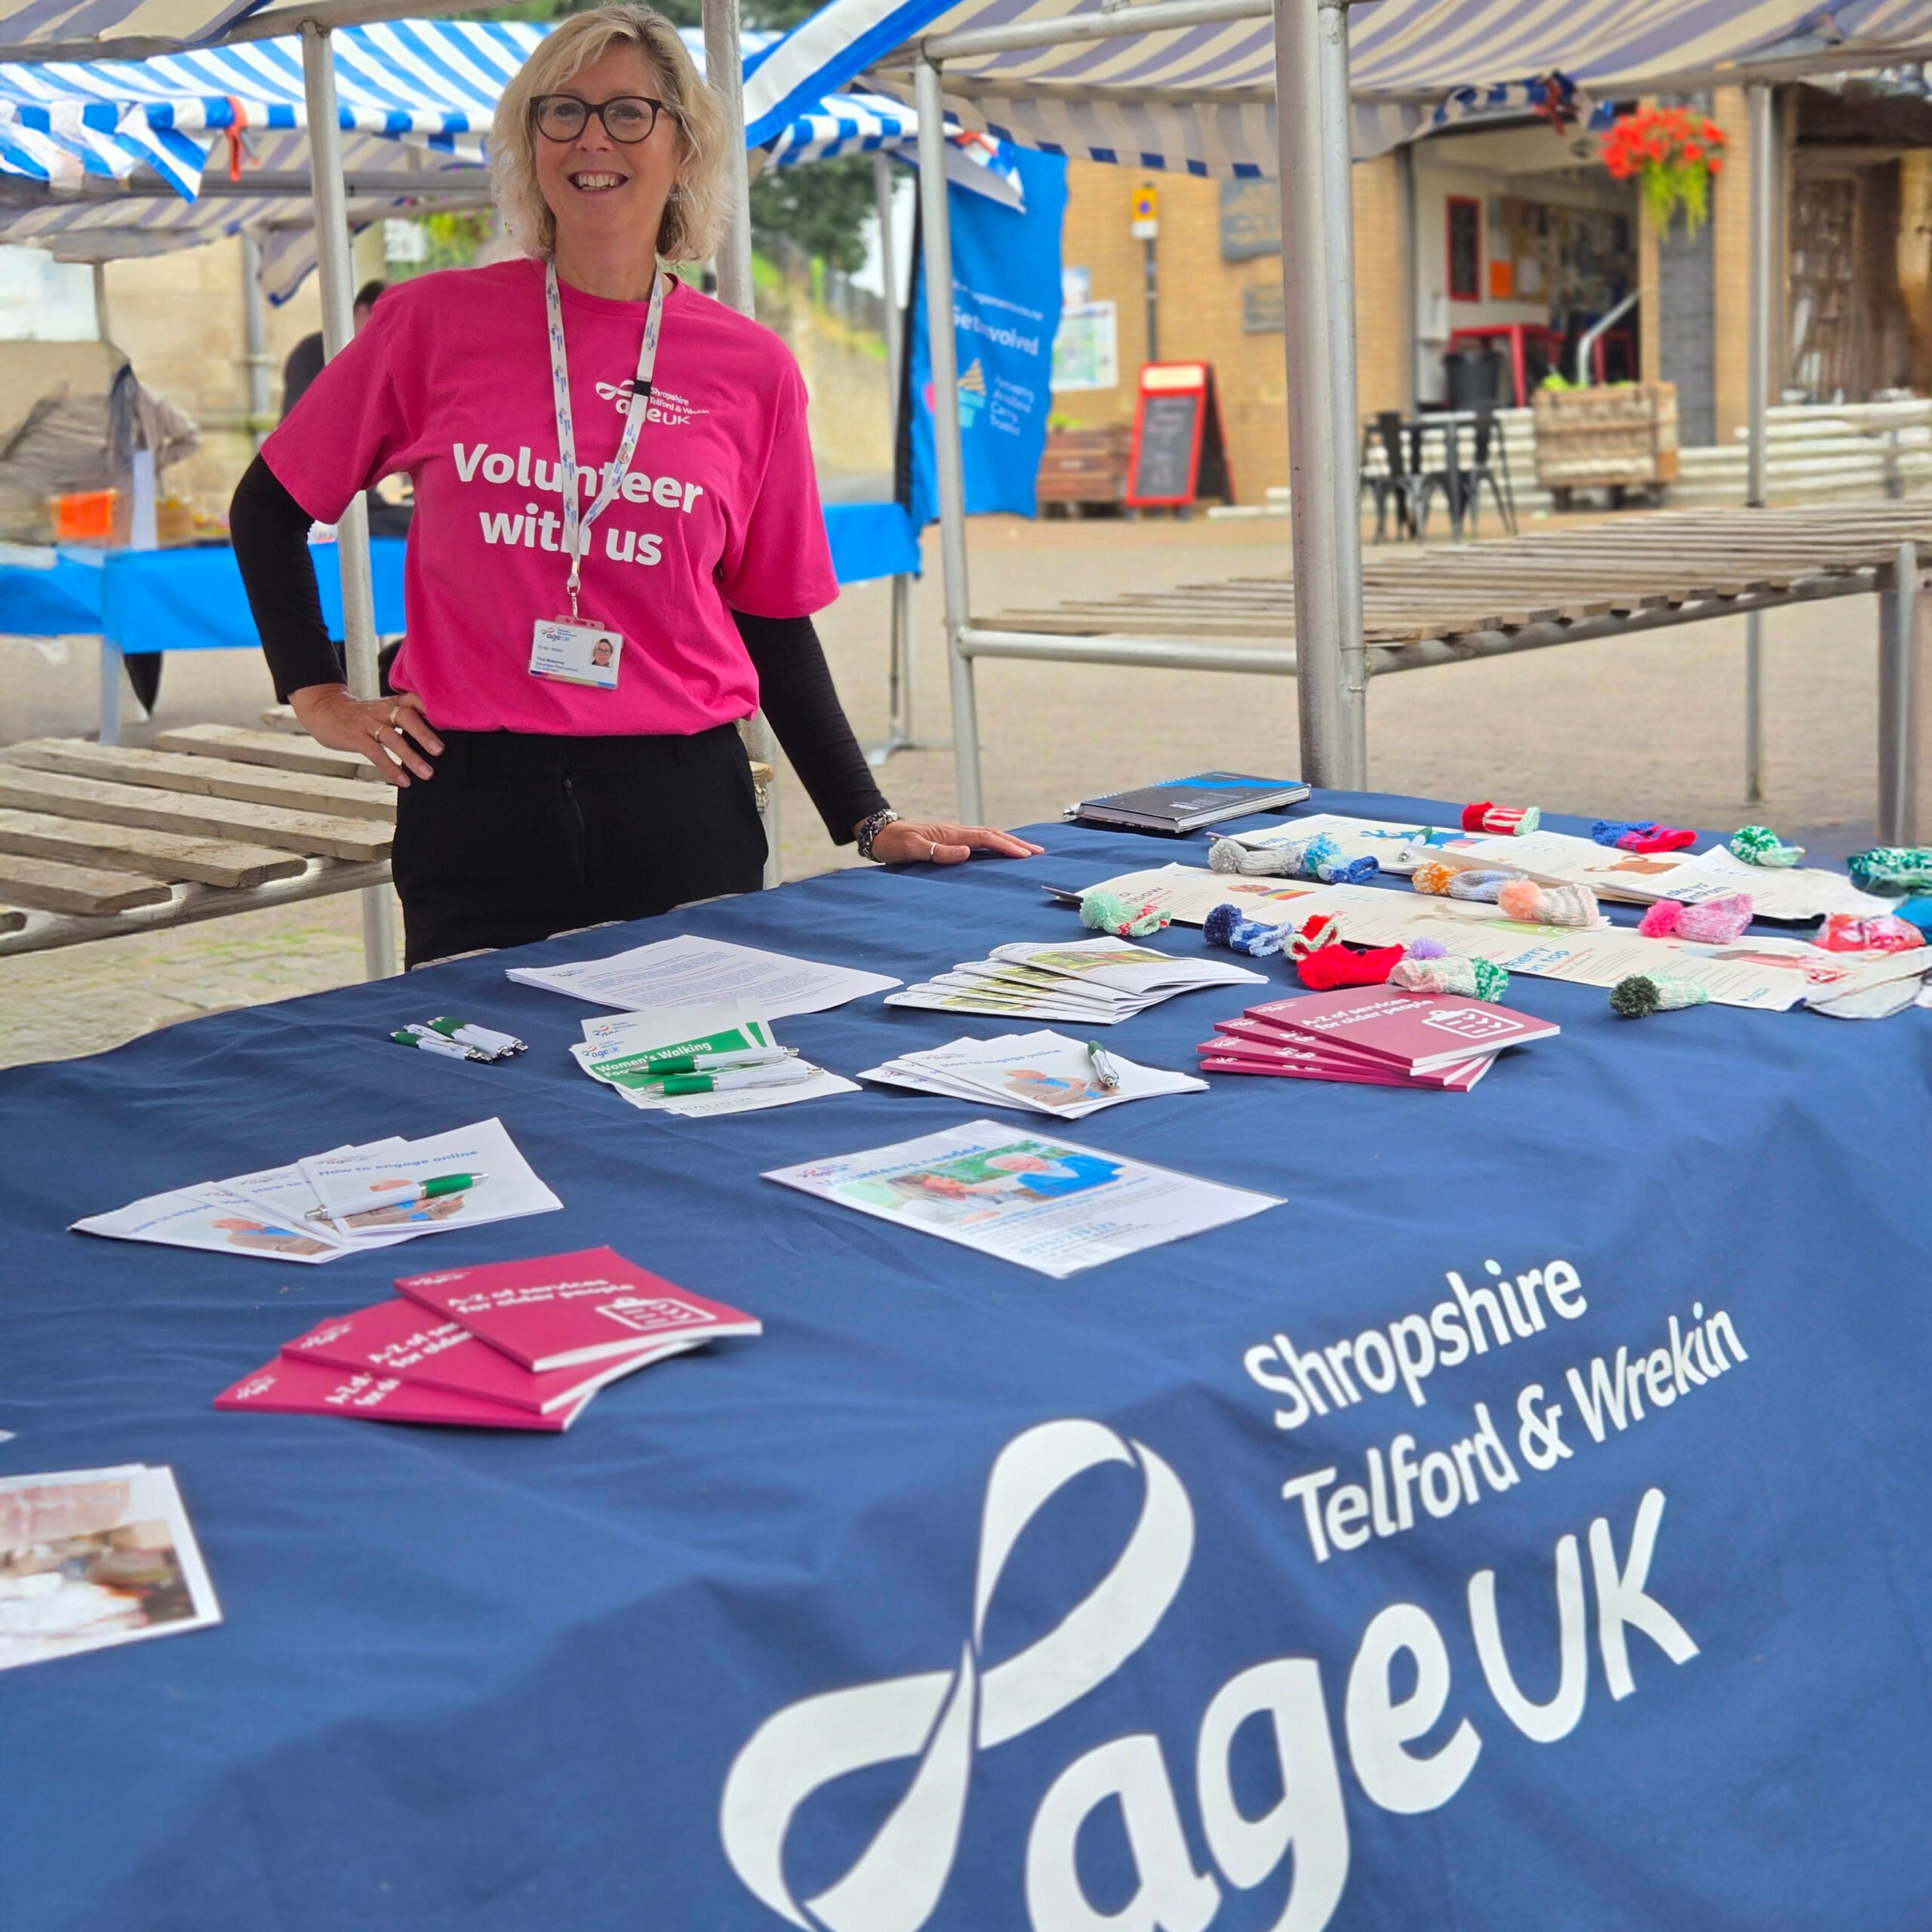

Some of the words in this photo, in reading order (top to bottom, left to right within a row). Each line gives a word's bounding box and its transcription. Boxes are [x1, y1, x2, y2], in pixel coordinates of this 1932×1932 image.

[649, 396, 674, 411] Telford
[651, 386, 689, 405] Shropshire
[616, 398, 661, 423] ae
[663, 412, 691, 425] UK
[453, 443, 703, 513] Volunteer
[479, 503, 592, 556] with
[605, 528, 663, 566] us
[1541, 950, 1571, 963] top
[1314, 1019, 1342, 1030] for
[1344, 1010, 1381, 1026] older
[1385, 998, 1435, 1016] people
[1330, 1011, 1349, 1020] of
[1352, 998, 1410, 1017] services
[595, 1055, 657, 1072] Women's
[657, 1041, 712, 1059] Walking
[375, 1159, 429, 1170] engage
[433, 1150, 478, 1162] online
[817, 1162, 919, 1186] Volunteers
[921, 1144, 986, 1165] needed
[1244, 1260, 1586, 1429] Shropshire
[1281, 1402, 1518, 1562] Telford
[1516, 1384, 1574, 1470] &
[1566, 1302, 1749, 1443] Wrekin
[1024, 1601, 1483, 1932] age
[1466, 1487, 1701, 1743] UK
